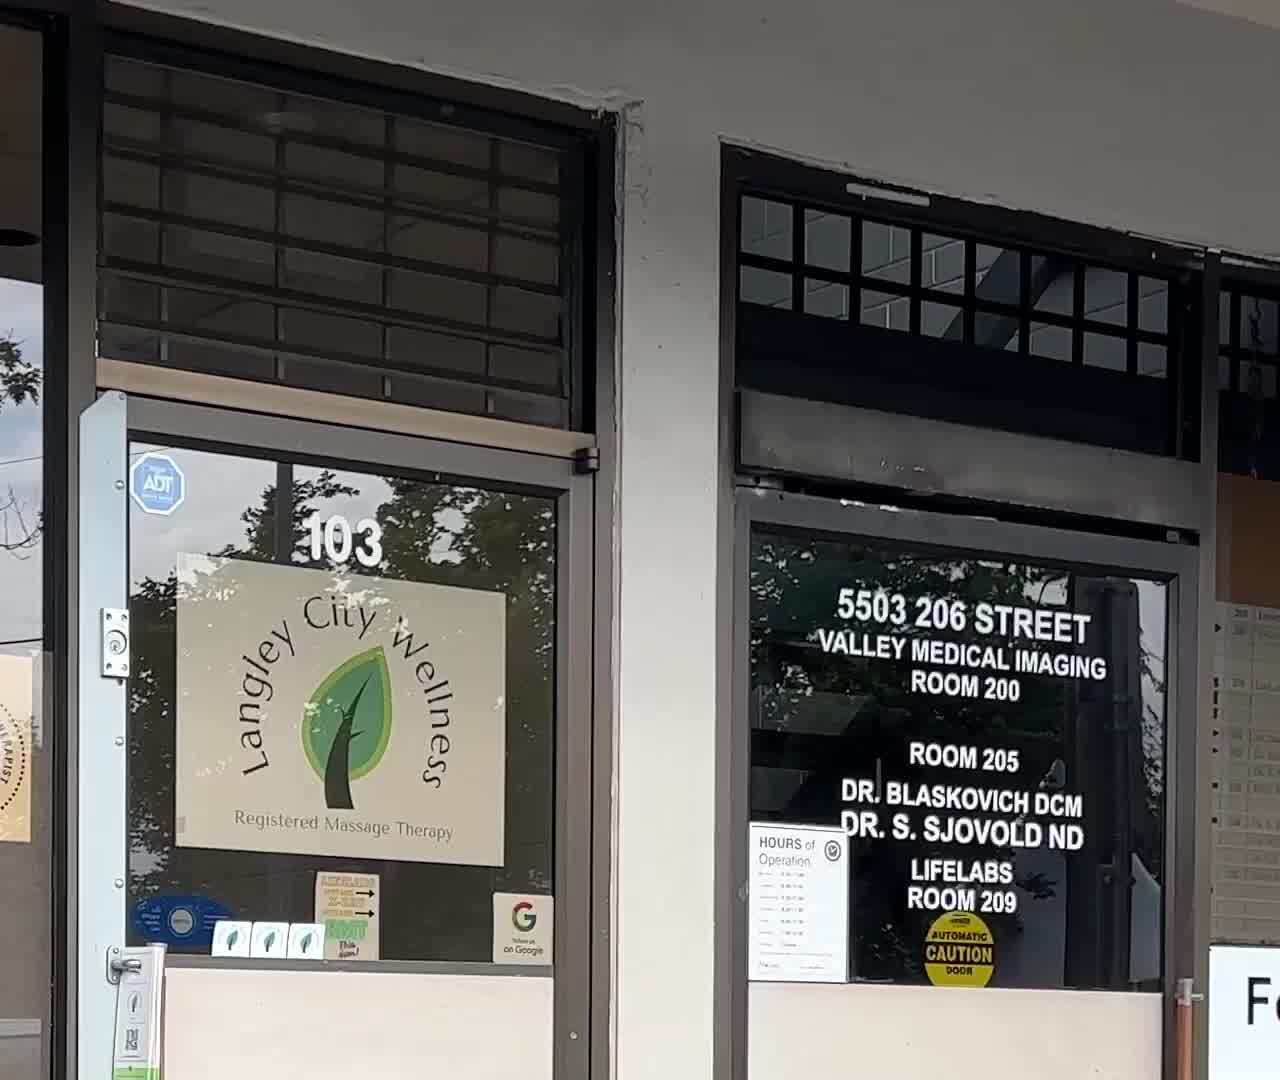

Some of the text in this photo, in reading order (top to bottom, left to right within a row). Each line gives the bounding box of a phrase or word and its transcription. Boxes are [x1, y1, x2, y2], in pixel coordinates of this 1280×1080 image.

[144, 474, 173, 493] ADT
[303, 514, 383, 567] 103
[837, 588, 1091, 644] 5503 206 STREET
[819, 628, 1107, 680] VALLEY MEDICAL IMAGING
[239, 595, 454, 789] Langley City Wellness
[911, 670, 1020, 701] ROOM 200
[909, 742, 1019, 772] ROOM 205
[842, 778, 1083, 818] DR. BLASKOVICH DCM
[234, 810, 454, 843] Registered Massage Therapy
[841, 810, 1084, 850] DR. S. SJOVOLD ND
[759, 836, 815, 850] HOURS of
[758, 853, 811, 867] Operation
[911, 858, 1013, 884] LIFELABS
[908, 887, 1017, 913] ROOM 209
[932, 931, 988, 942] AUTOMATIC
[926, 945, 993, 963] CAUTION
